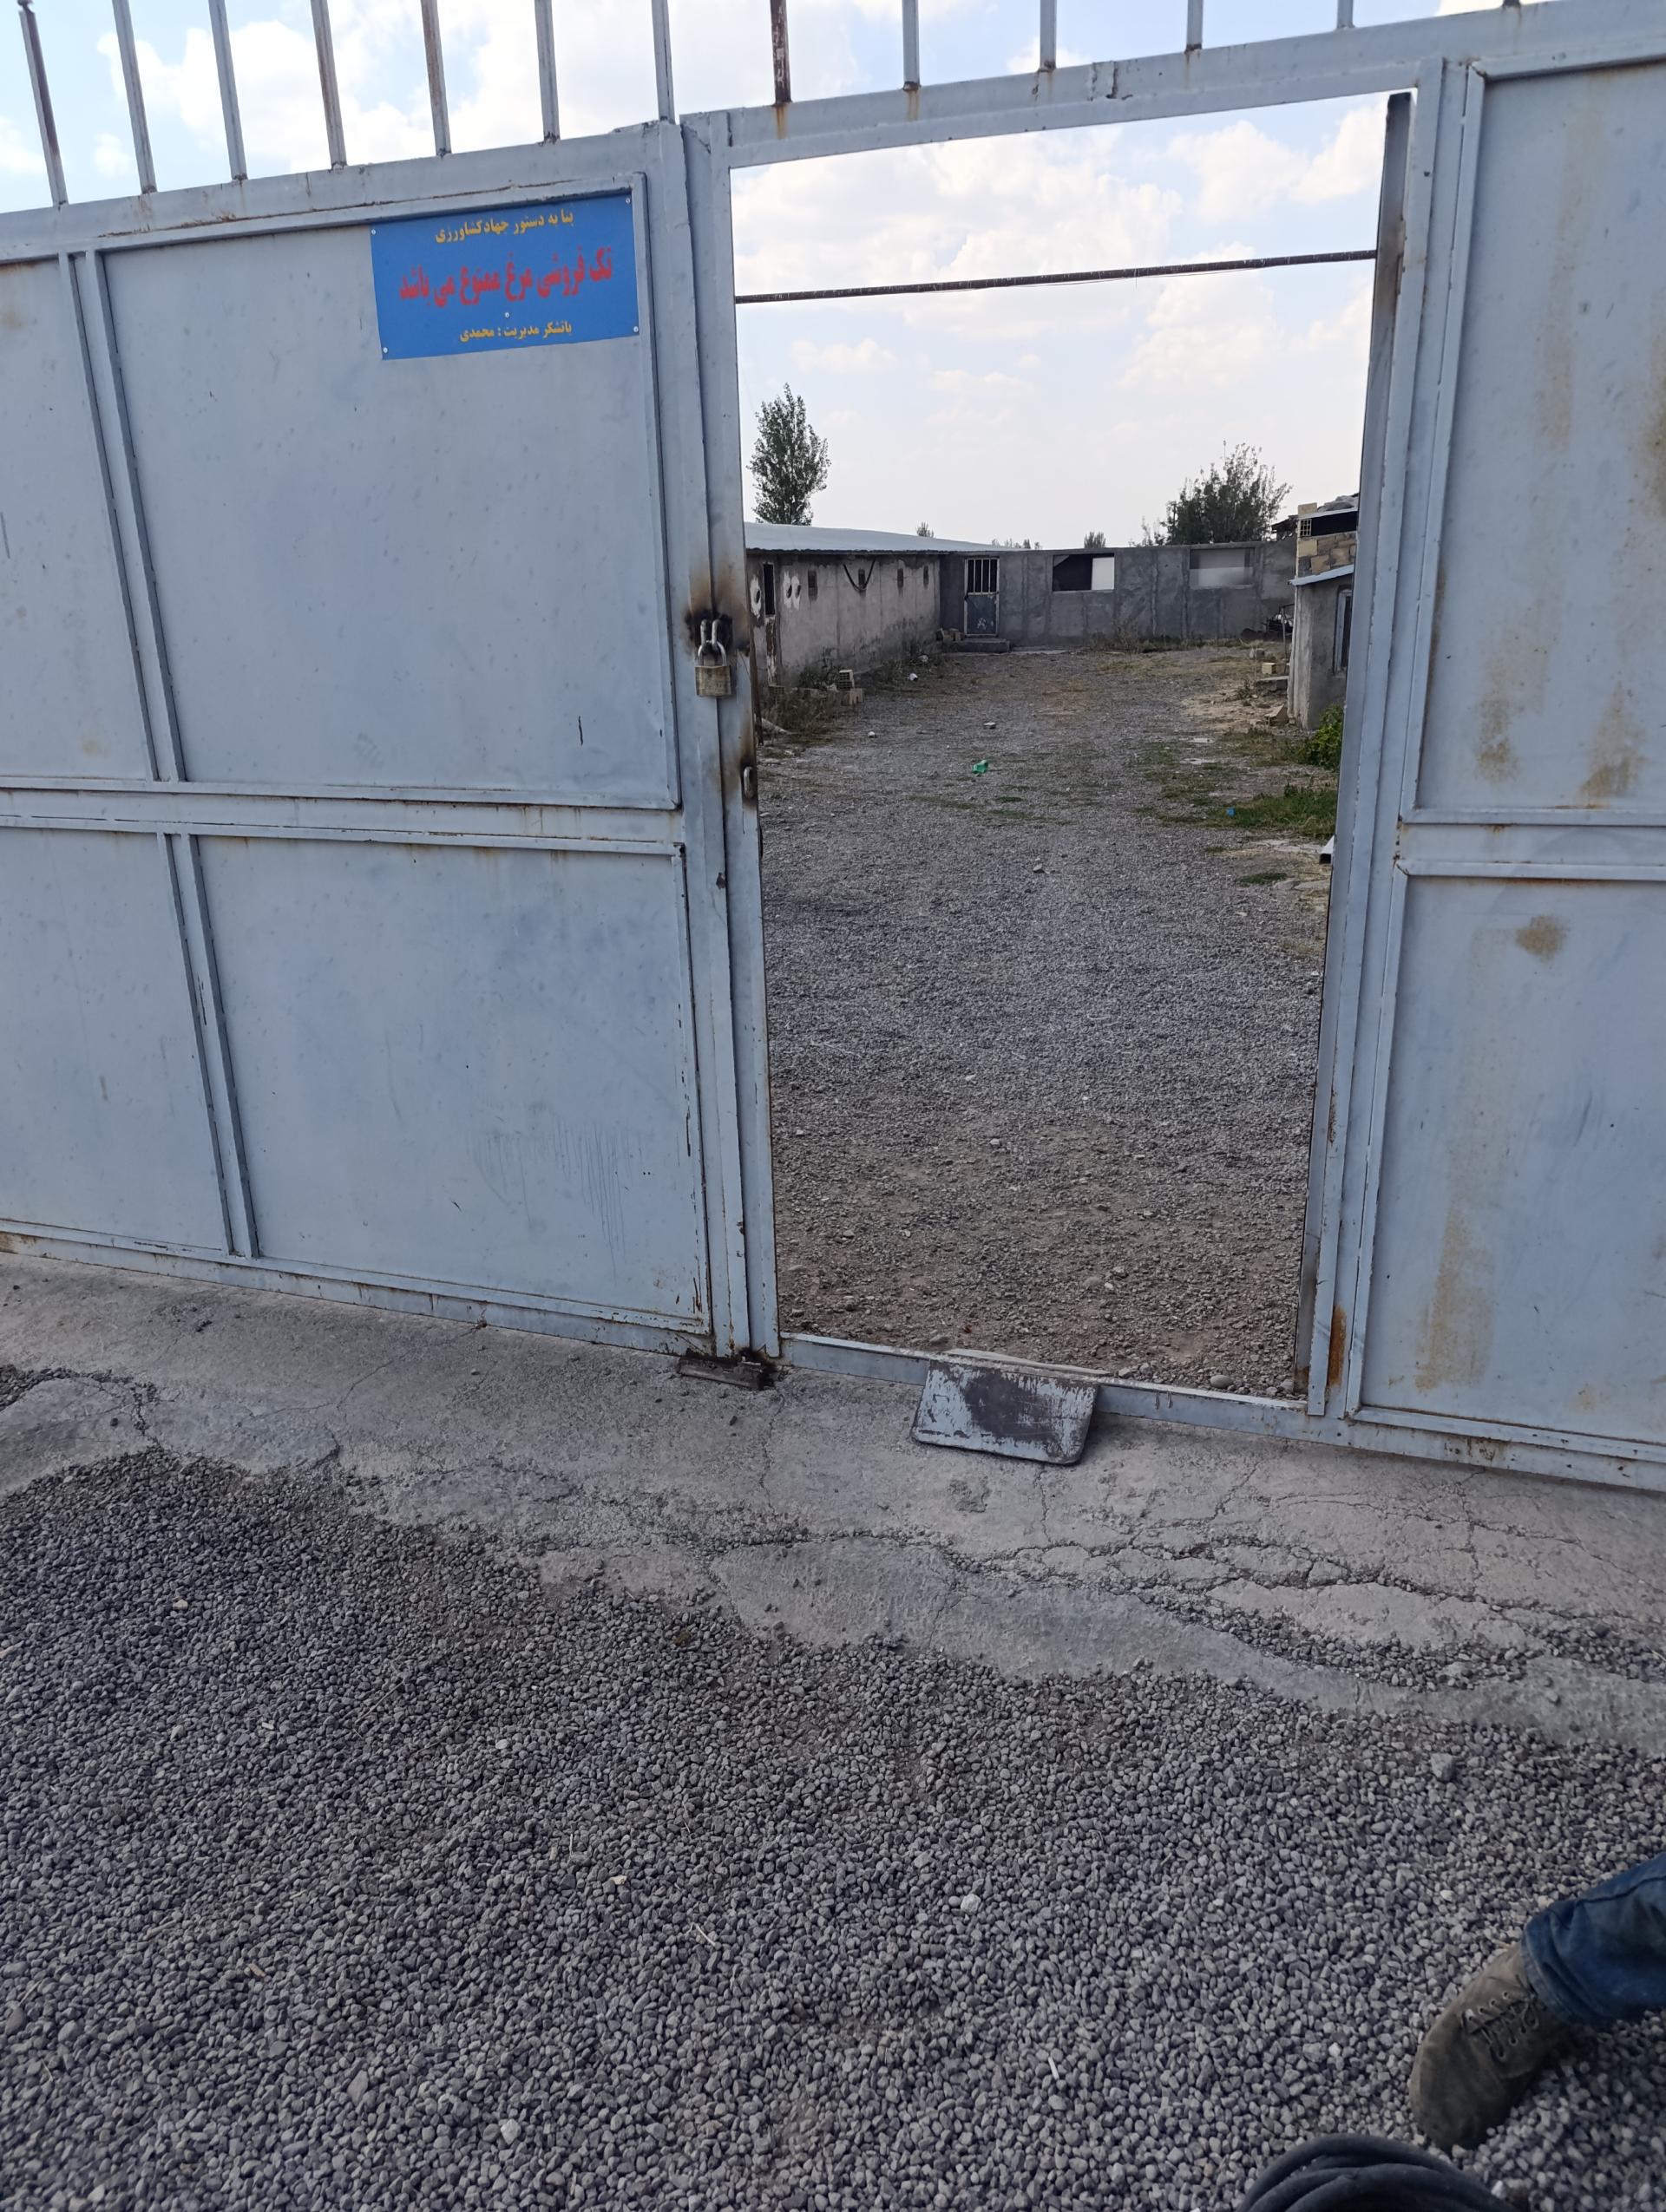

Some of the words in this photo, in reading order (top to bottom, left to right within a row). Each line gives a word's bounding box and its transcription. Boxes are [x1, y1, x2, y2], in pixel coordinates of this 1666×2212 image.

[514, 214, 545, 235] دستور
[548, 213, 559, 228] به
[561, 208, 574, 226] بنا
[505, 251, 533, 302] مرغ
[536, 244, 585, 298] فروشی
[589, 245, 612, 283] تک
[459, 265, 501, 306] ممنوع
[460, 329, 495, 343] محمدی
